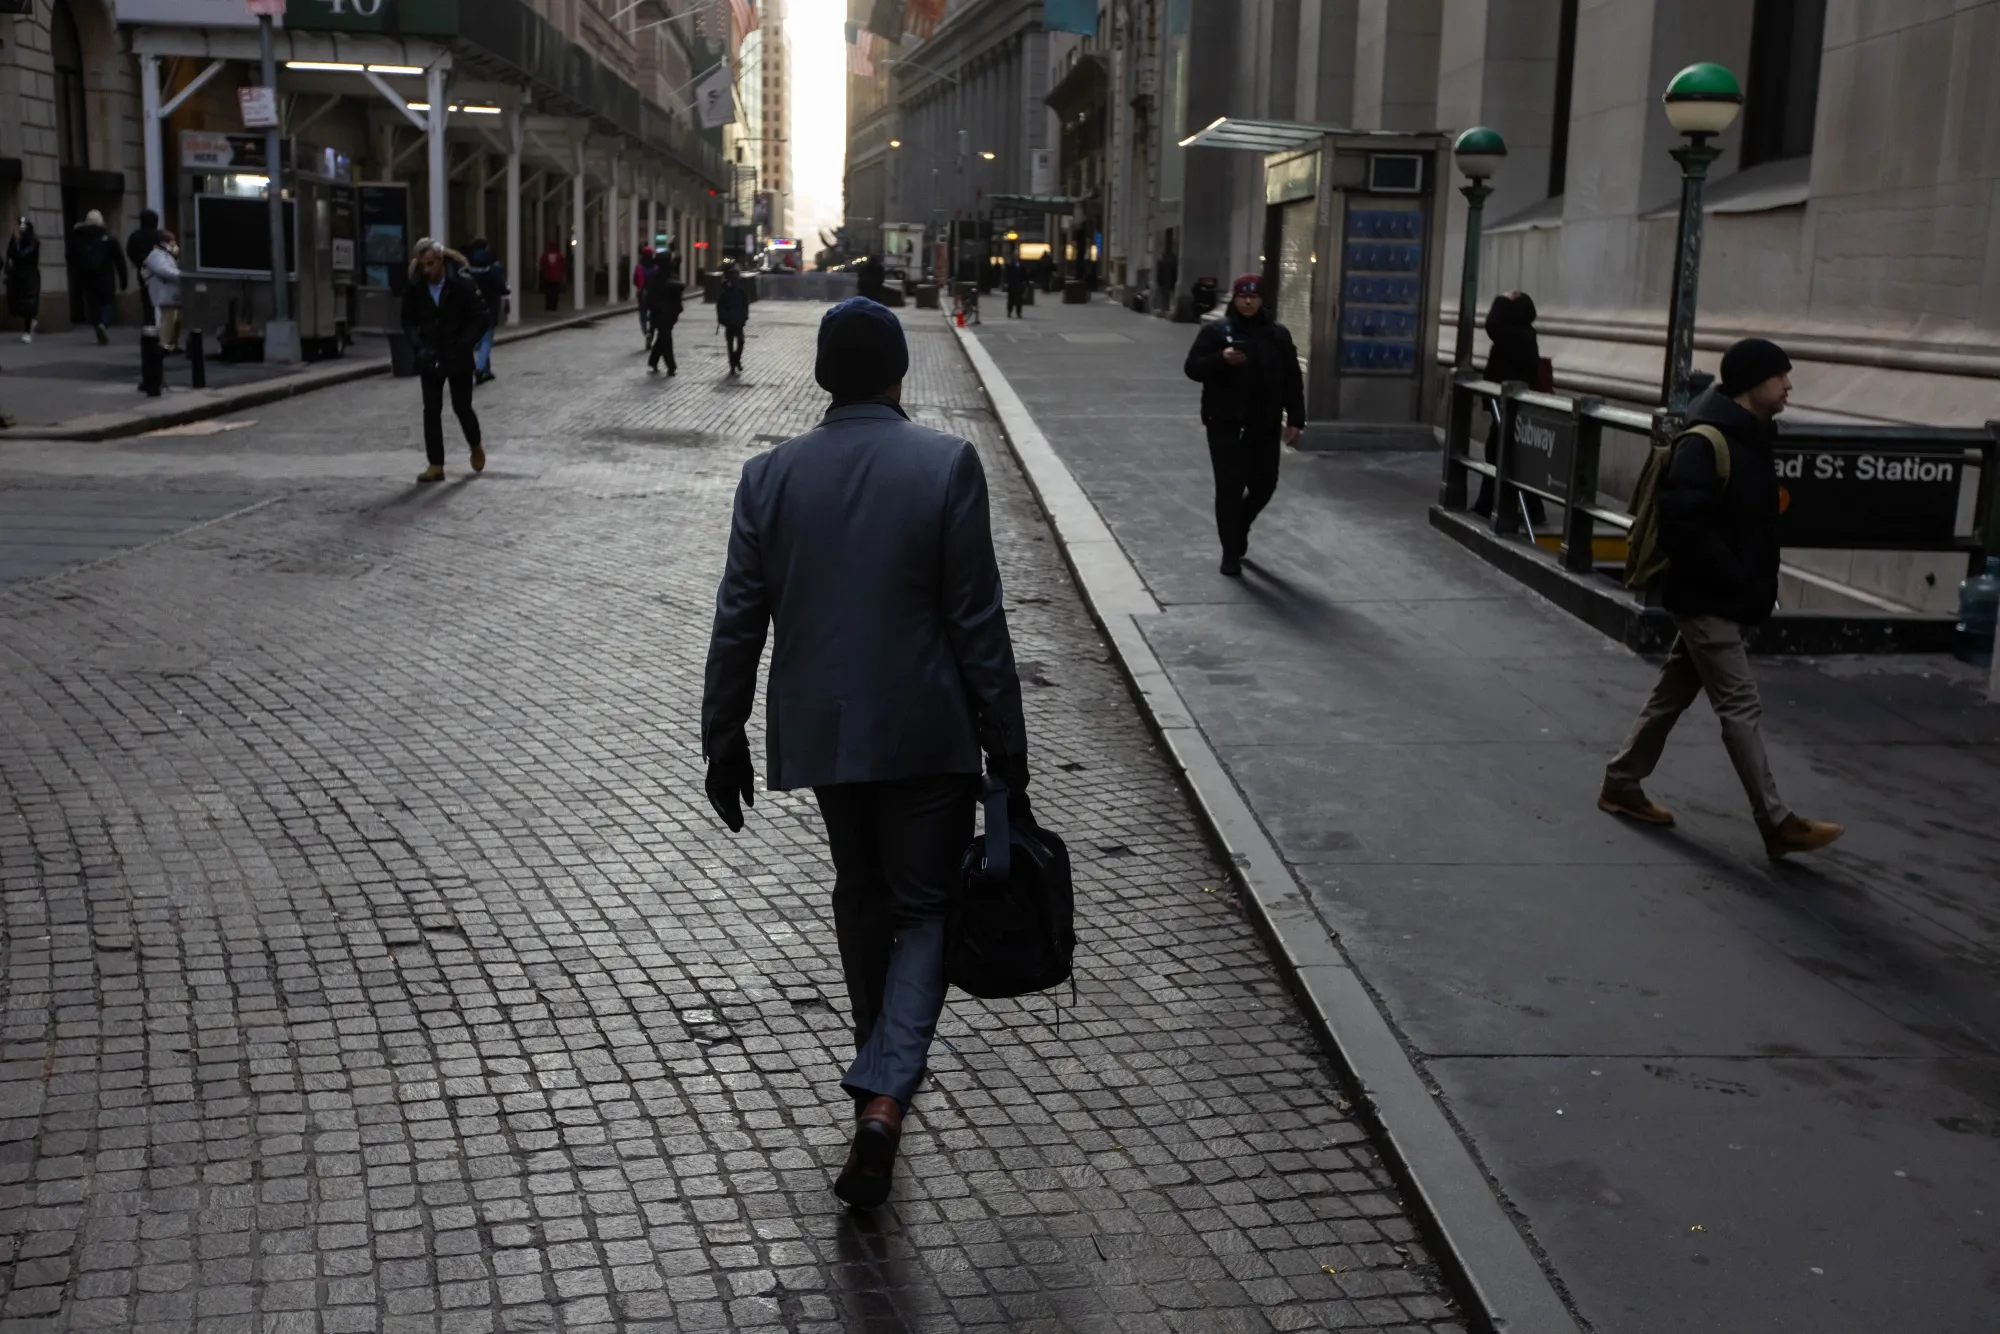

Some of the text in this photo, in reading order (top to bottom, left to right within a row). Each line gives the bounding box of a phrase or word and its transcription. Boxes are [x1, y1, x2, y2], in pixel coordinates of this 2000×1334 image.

[1513, 414, 1556, 459] Subway
[1773, 453, 1804, 479] ad
[1855, 454, 1954, 483] Station
